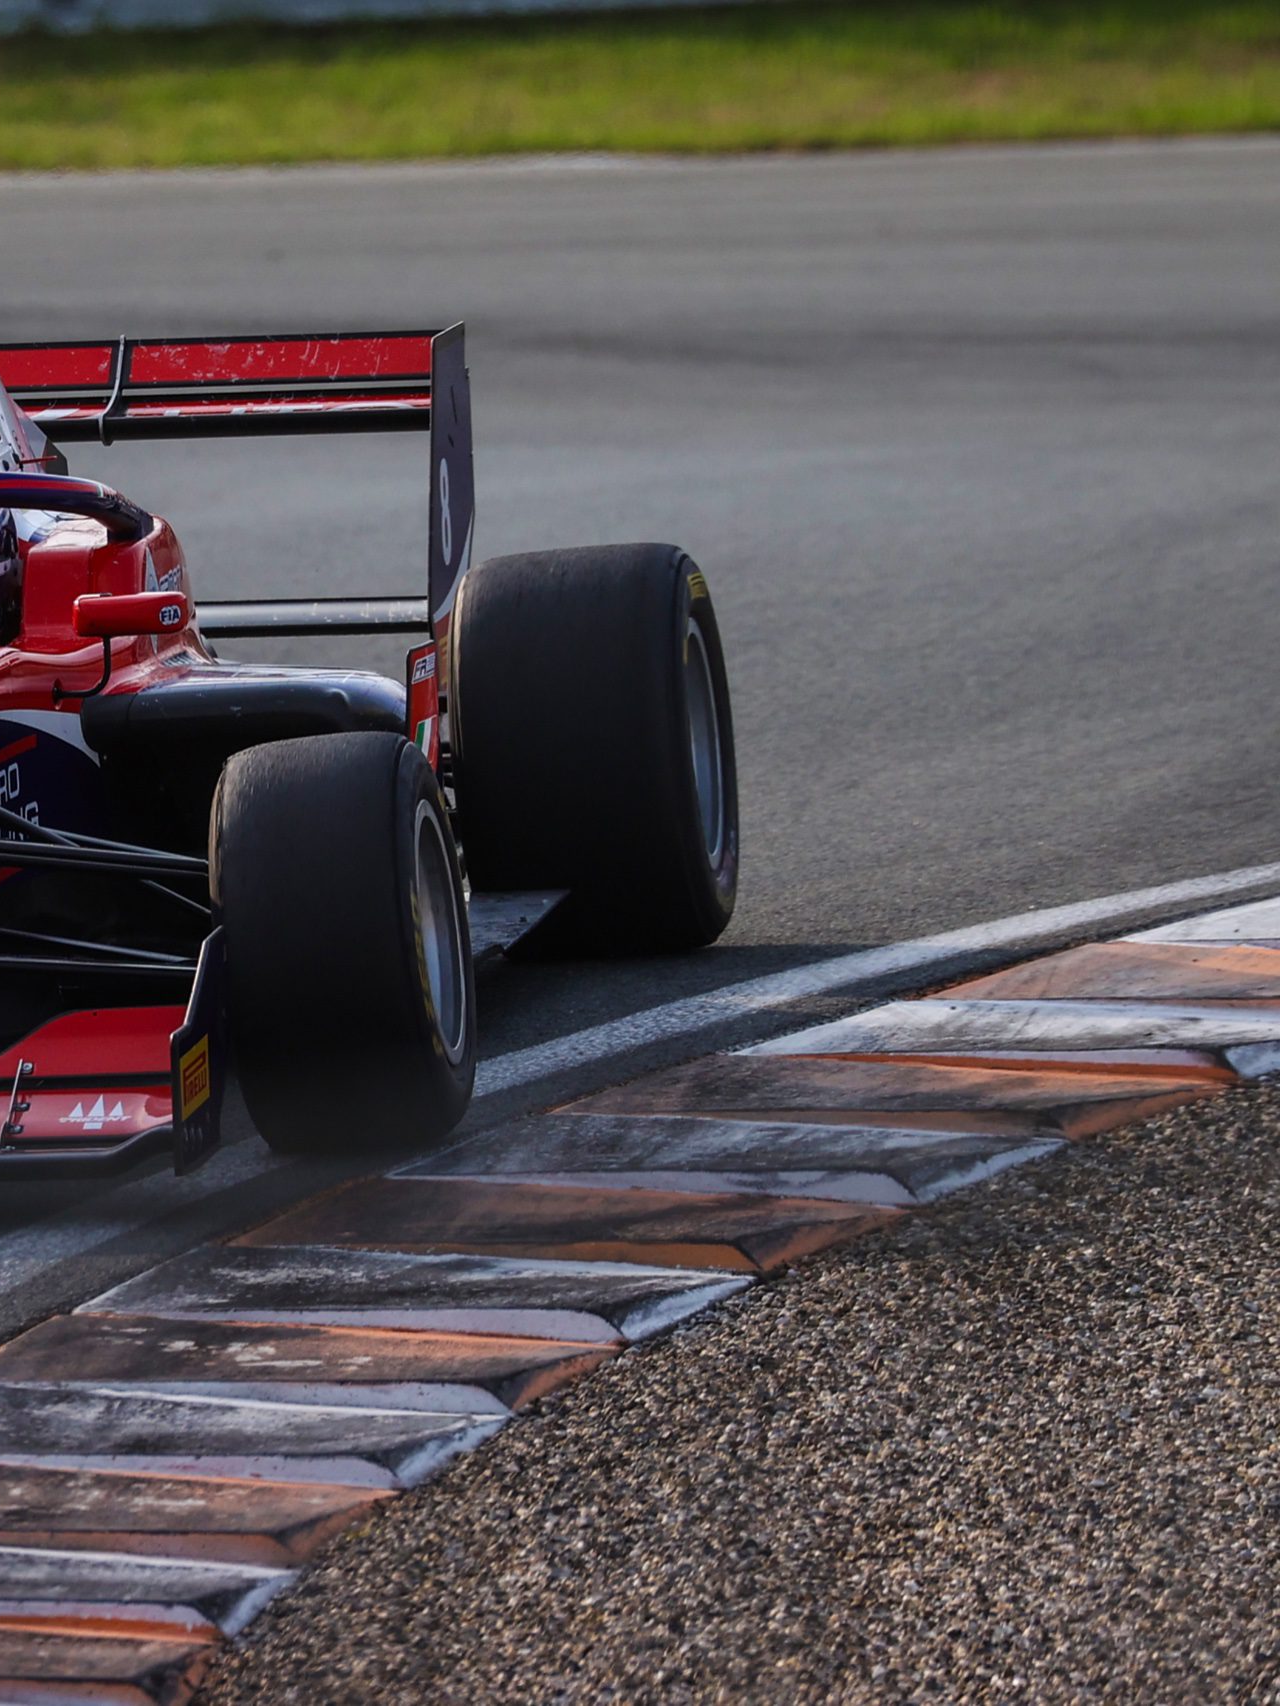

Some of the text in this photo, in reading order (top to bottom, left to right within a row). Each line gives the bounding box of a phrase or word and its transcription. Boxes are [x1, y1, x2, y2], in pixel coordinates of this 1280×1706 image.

[439, 457, 452, 566] 8
[161, 608, 180, 622] FIA
[183, 1050, 208, 1107] PIRELLI
